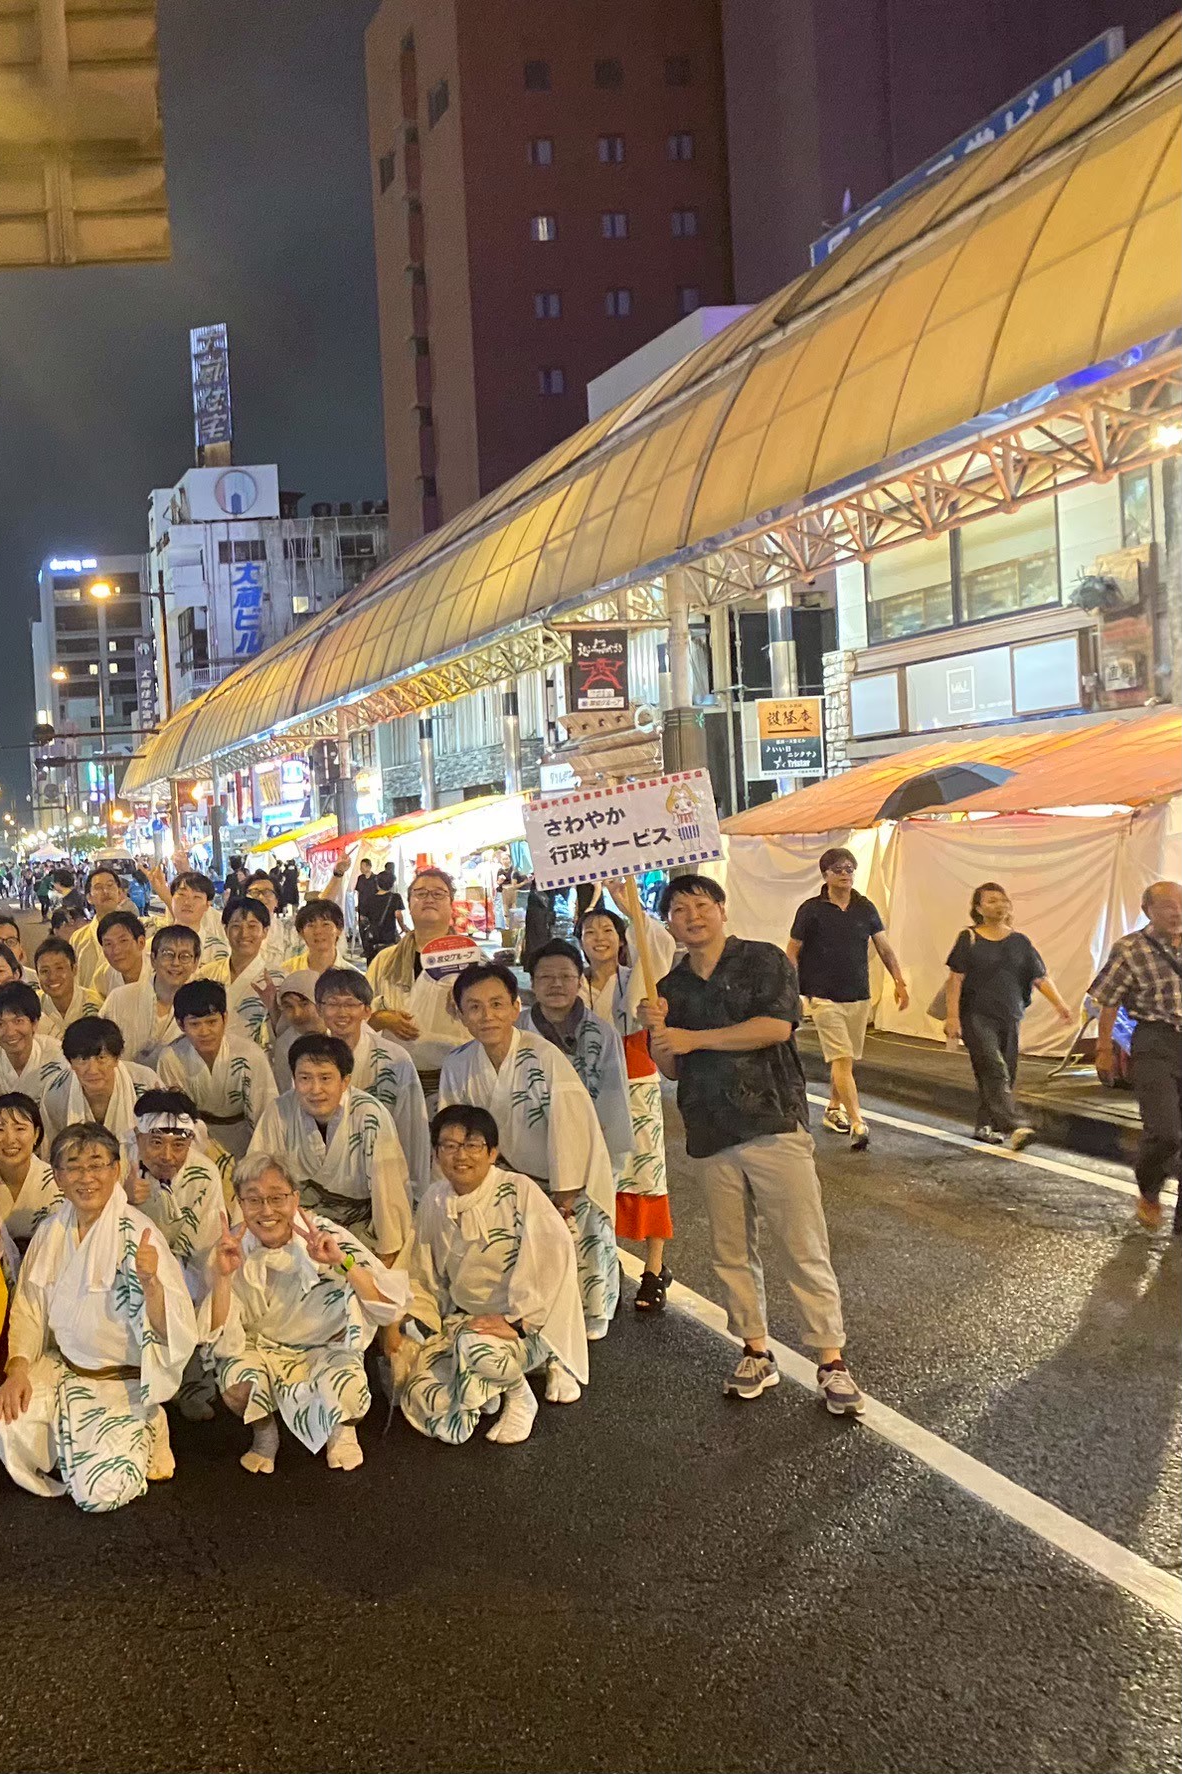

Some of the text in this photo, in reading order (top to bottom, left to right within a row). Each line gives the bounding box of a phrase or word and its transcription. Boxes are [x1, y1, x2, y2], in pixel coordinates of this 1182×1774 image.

[543, 806, 627, 837] さわやか
[549, 826, 673, 866] 行政サービス
